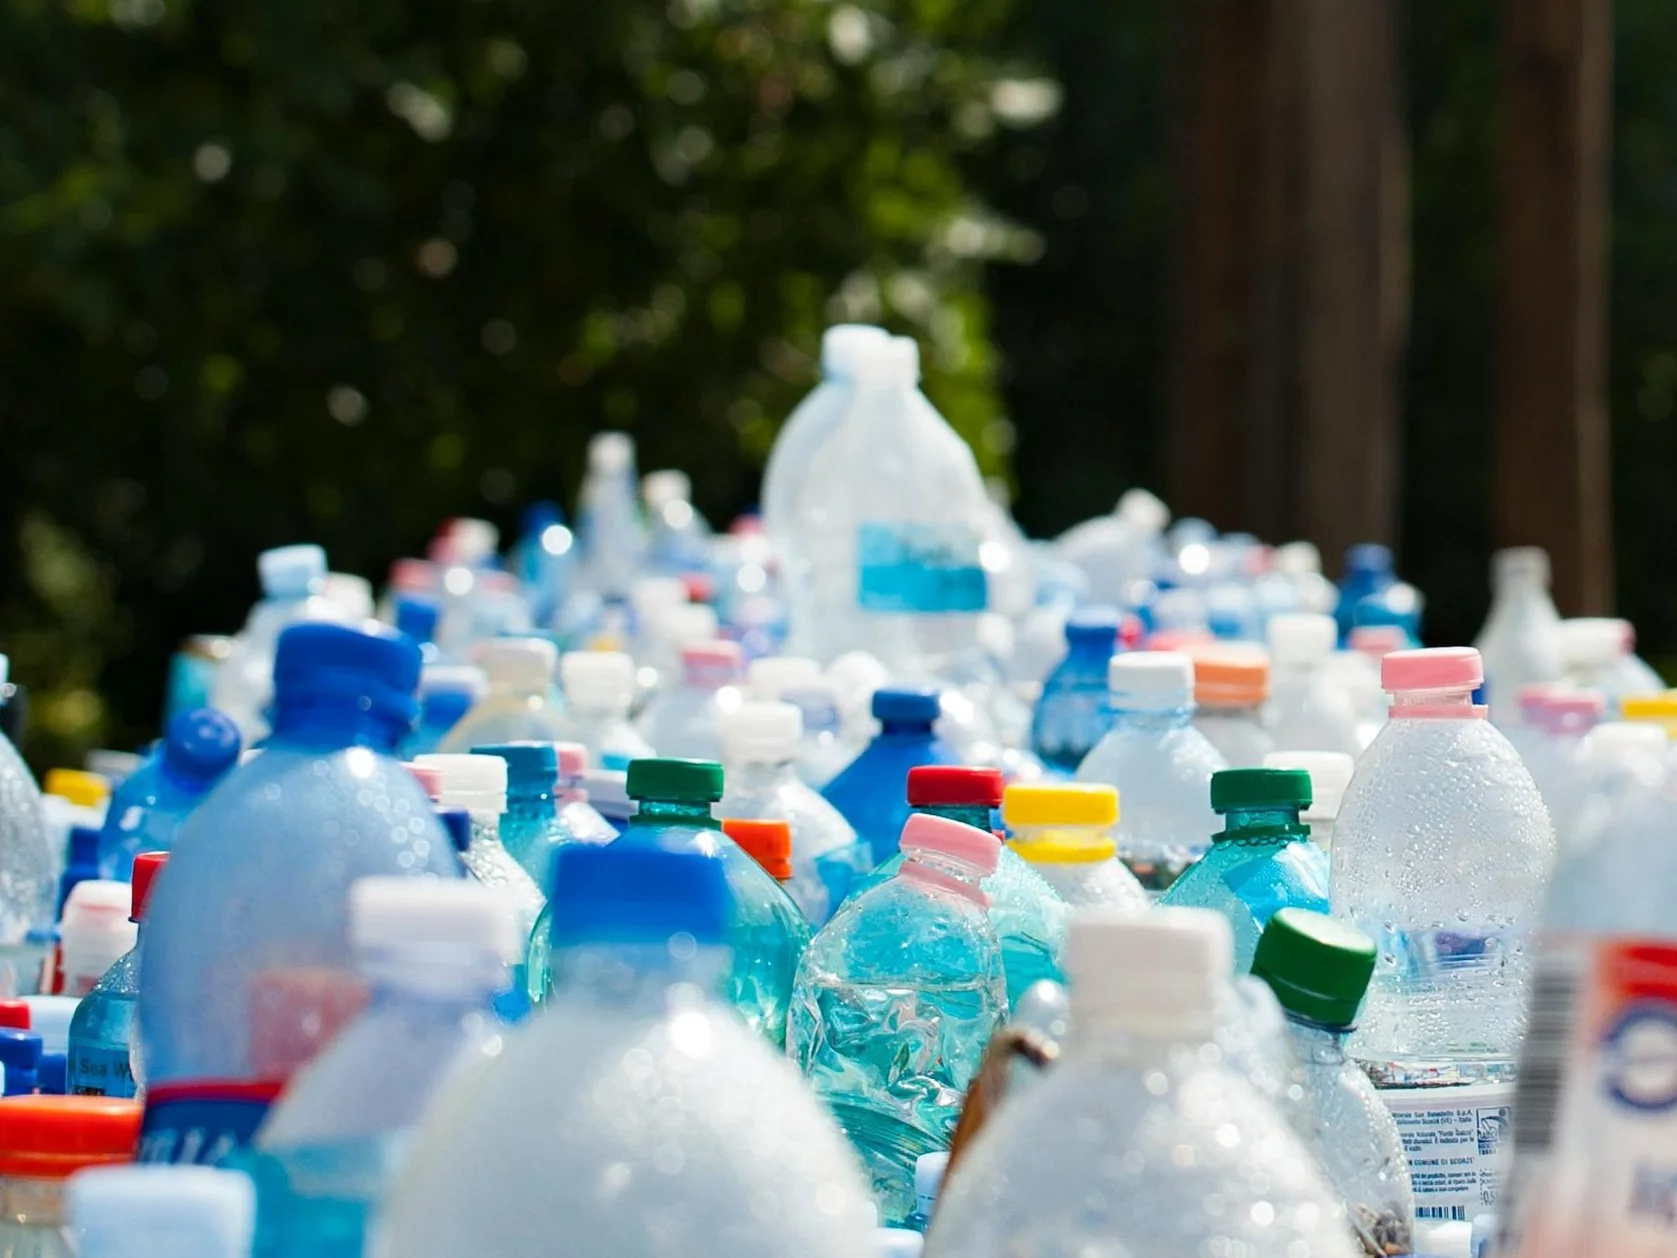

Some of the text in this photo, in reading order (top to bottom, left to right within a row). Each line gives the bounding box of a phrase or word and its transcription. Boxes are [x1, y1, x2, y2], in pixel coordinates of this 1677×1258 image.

[81, 1058, 108, 1077] Sea
[1413, 1158, 1439, 1166] COMUNE
[1440, 1158, 1448, 1166] DI
